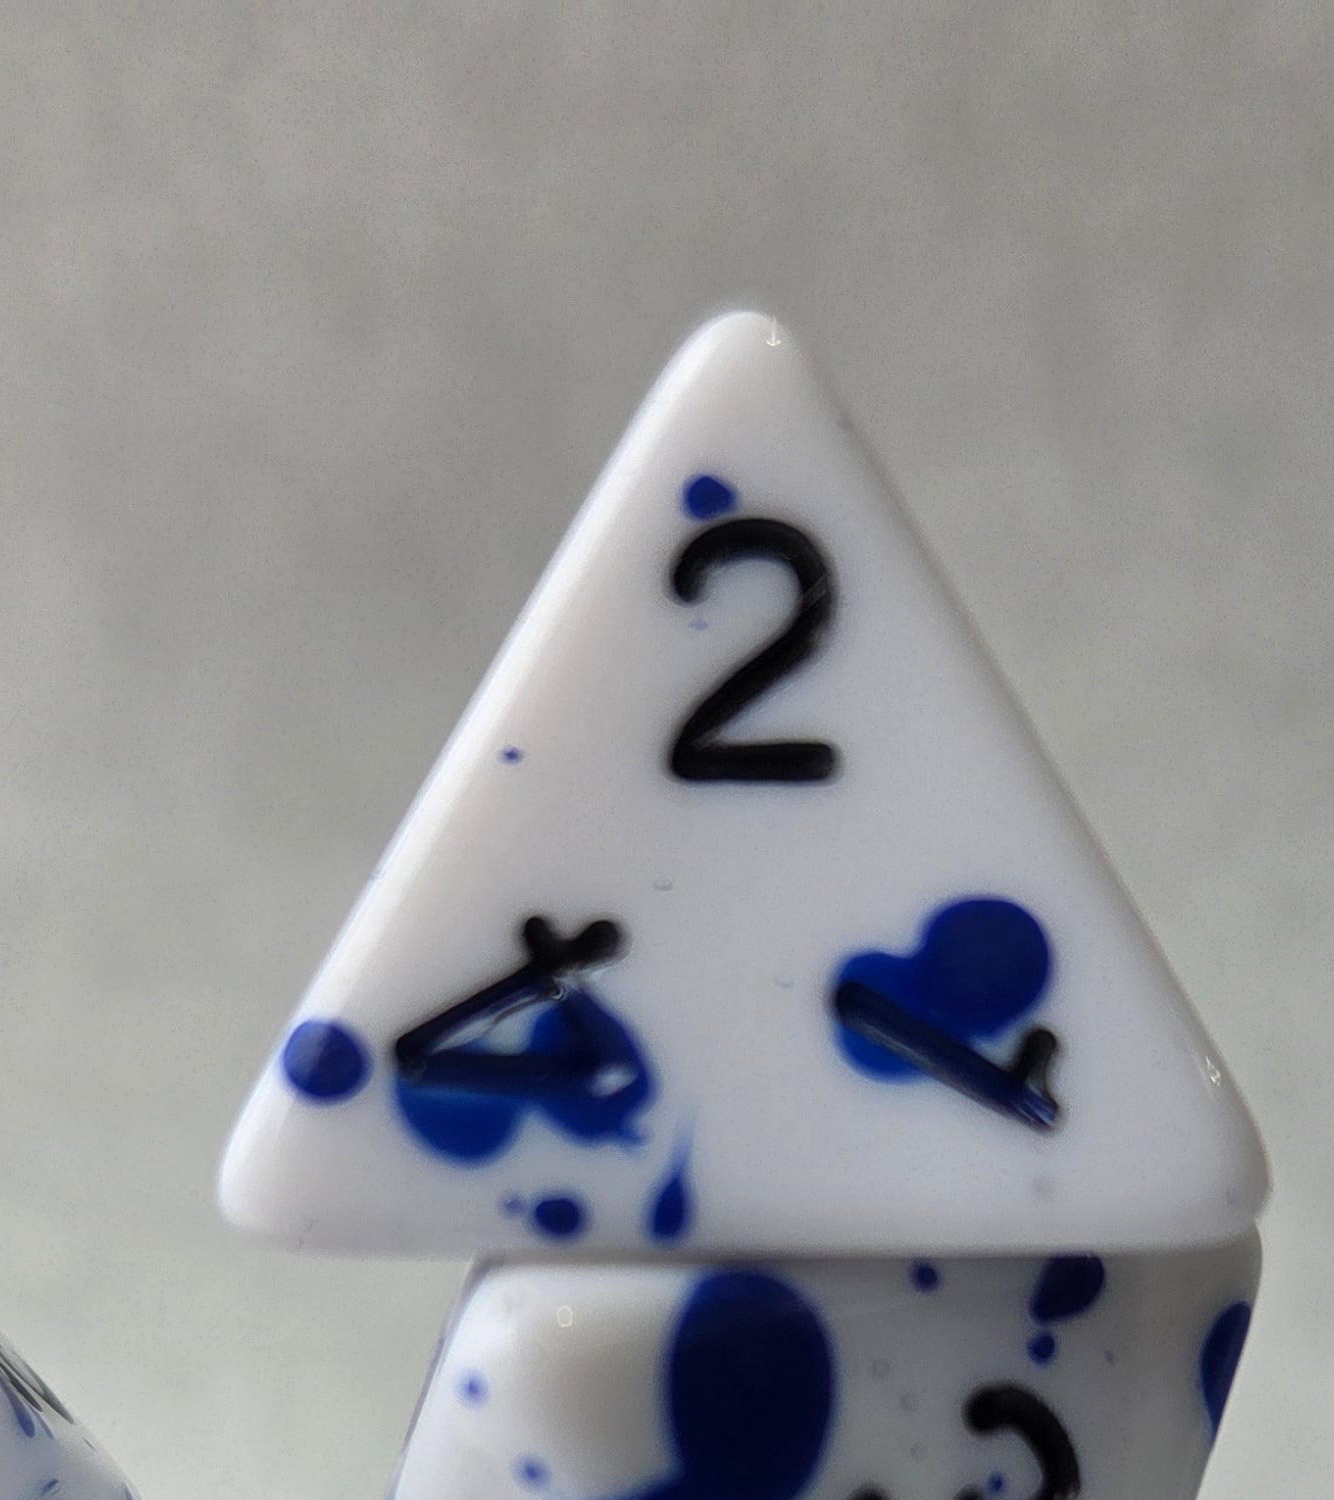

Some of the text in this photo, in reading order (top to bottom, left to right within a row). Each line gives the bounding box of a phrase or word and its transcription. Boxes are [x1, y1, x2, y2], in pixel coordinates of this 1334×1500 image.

[670, 516, 839, 783] 2
[393, 915, 637, 1098] 4
[829, 981, 1061, 1132] 1
